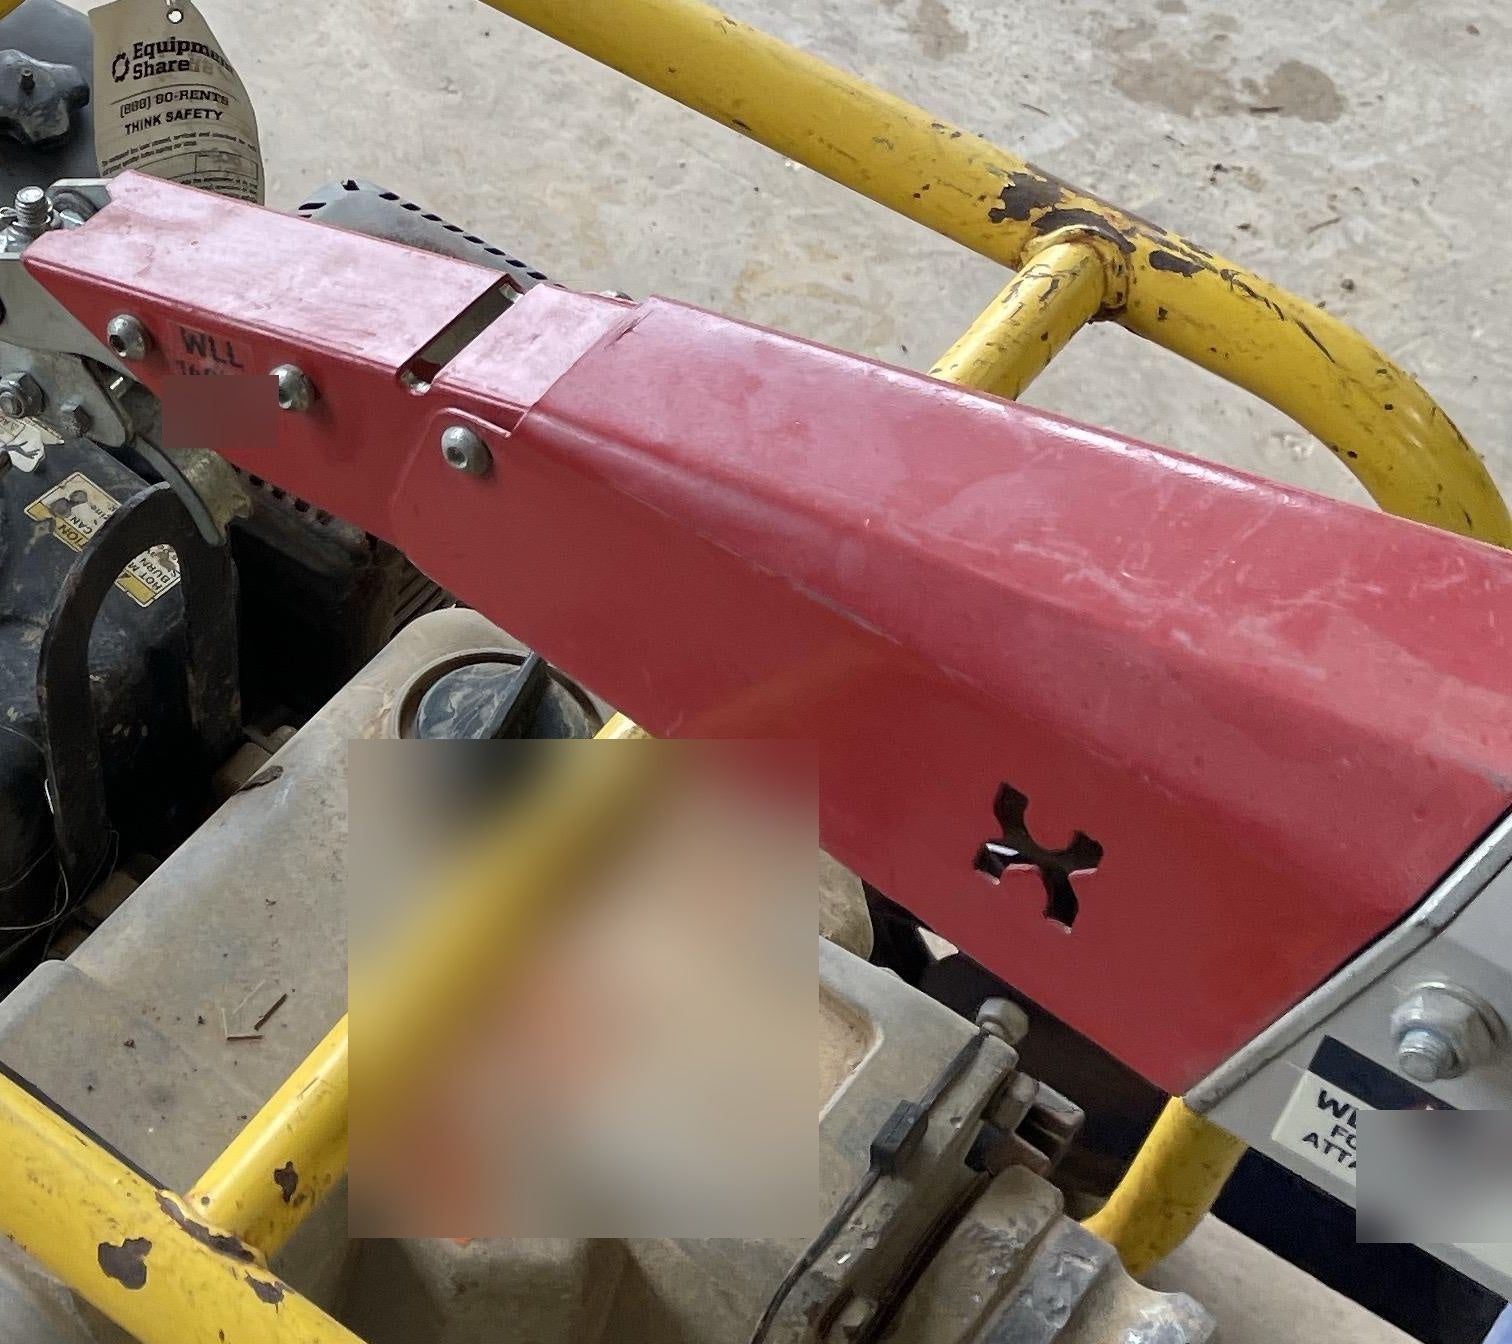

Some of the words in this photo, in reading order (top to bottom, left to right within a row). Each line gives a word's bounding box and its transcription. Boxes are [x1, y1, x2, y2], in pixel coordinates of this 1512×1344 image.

[132, 60, 191, 80] Share
[124, 113, 162, 135] THINK
[165, 108, 224, 122] SAFETY
[180, 326, 245, 369] WLL
